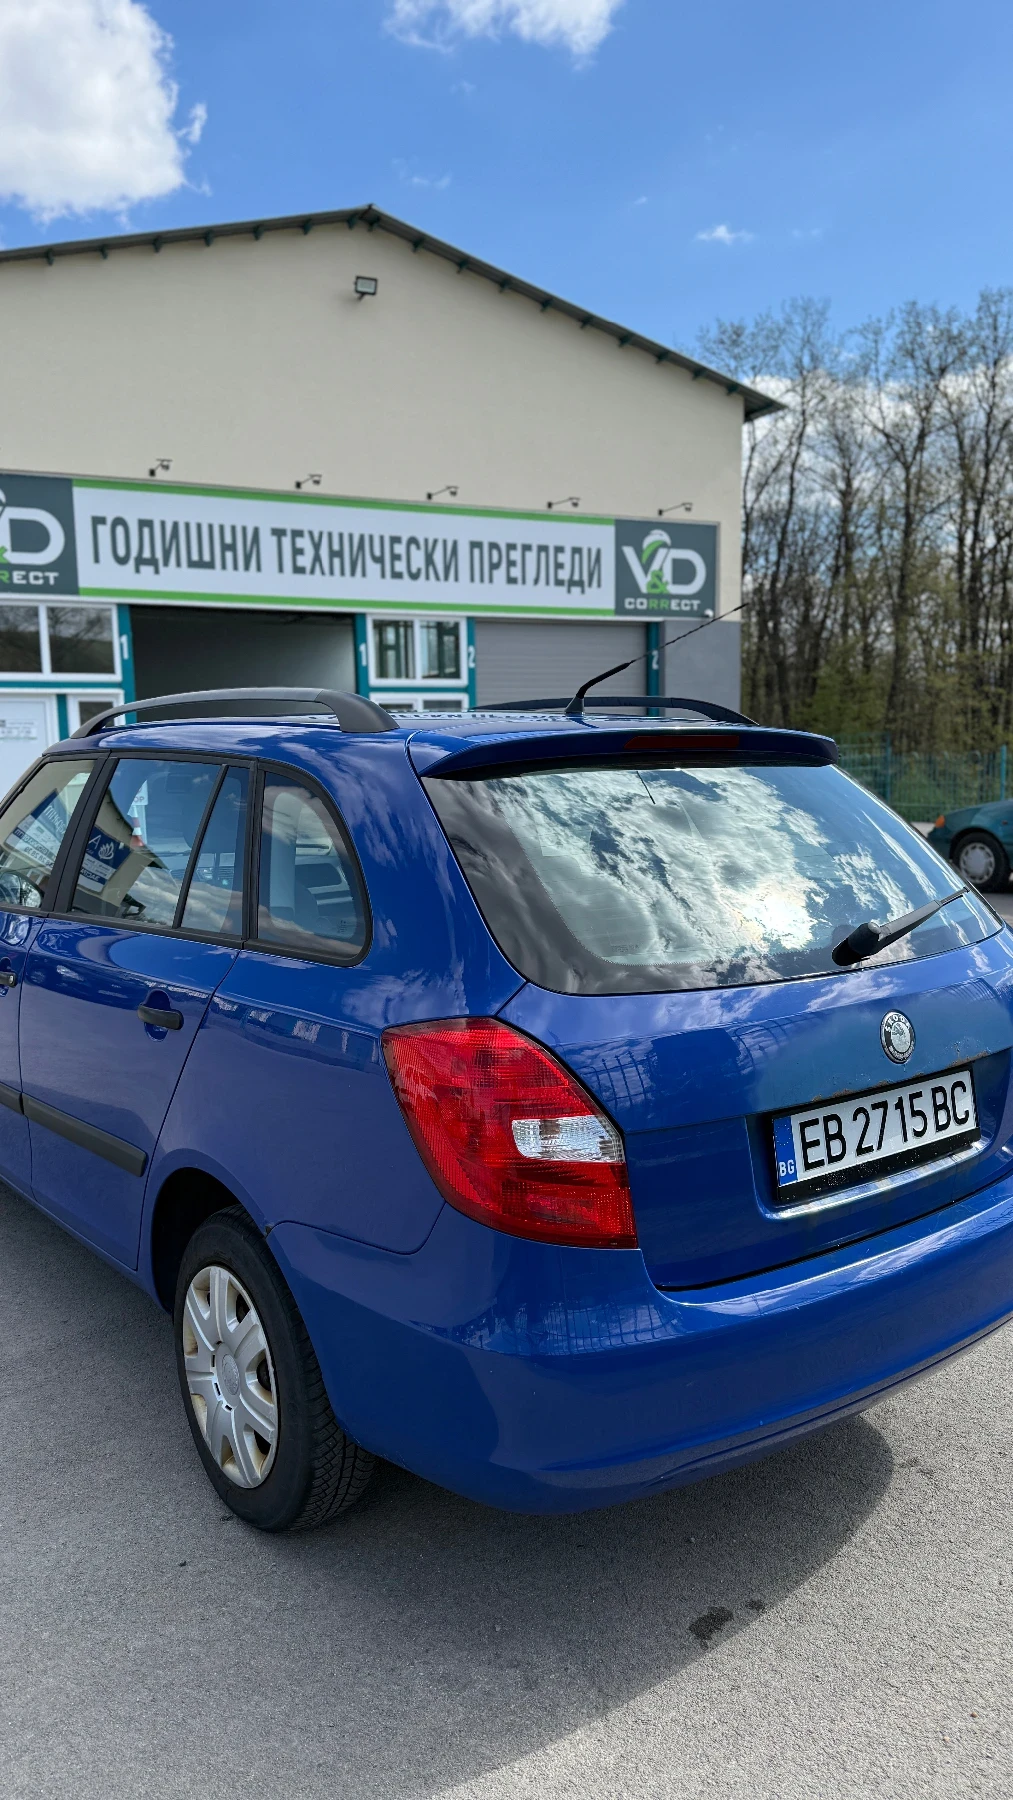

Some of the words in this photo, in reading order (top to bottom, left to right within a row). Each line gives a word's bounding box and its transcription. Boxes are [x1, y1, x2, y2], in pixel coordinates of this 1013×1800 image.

[91, 515, 262, 575] ГОДИШНИ
[270, 527, 459, 584] ТЕХНИЧЕСКИ
[468, 539, 602, 595] ПРЕГЛЕДИ
[621, 545, 707, 595] V&D
[624, 597, 701, 611] CORRECT
[120, 634, 129, 660] 1
[359, 642, 367, 667] 1
[468, 645, 476, 668] 2
[651, 650, 660, 670] 2
[799, 1113, 847, 1172] EB
[852, 1090, 928, 1157] 2715
[930, 1080, 970, 1133] BC
[779, 1159, 795, 1177] BG
